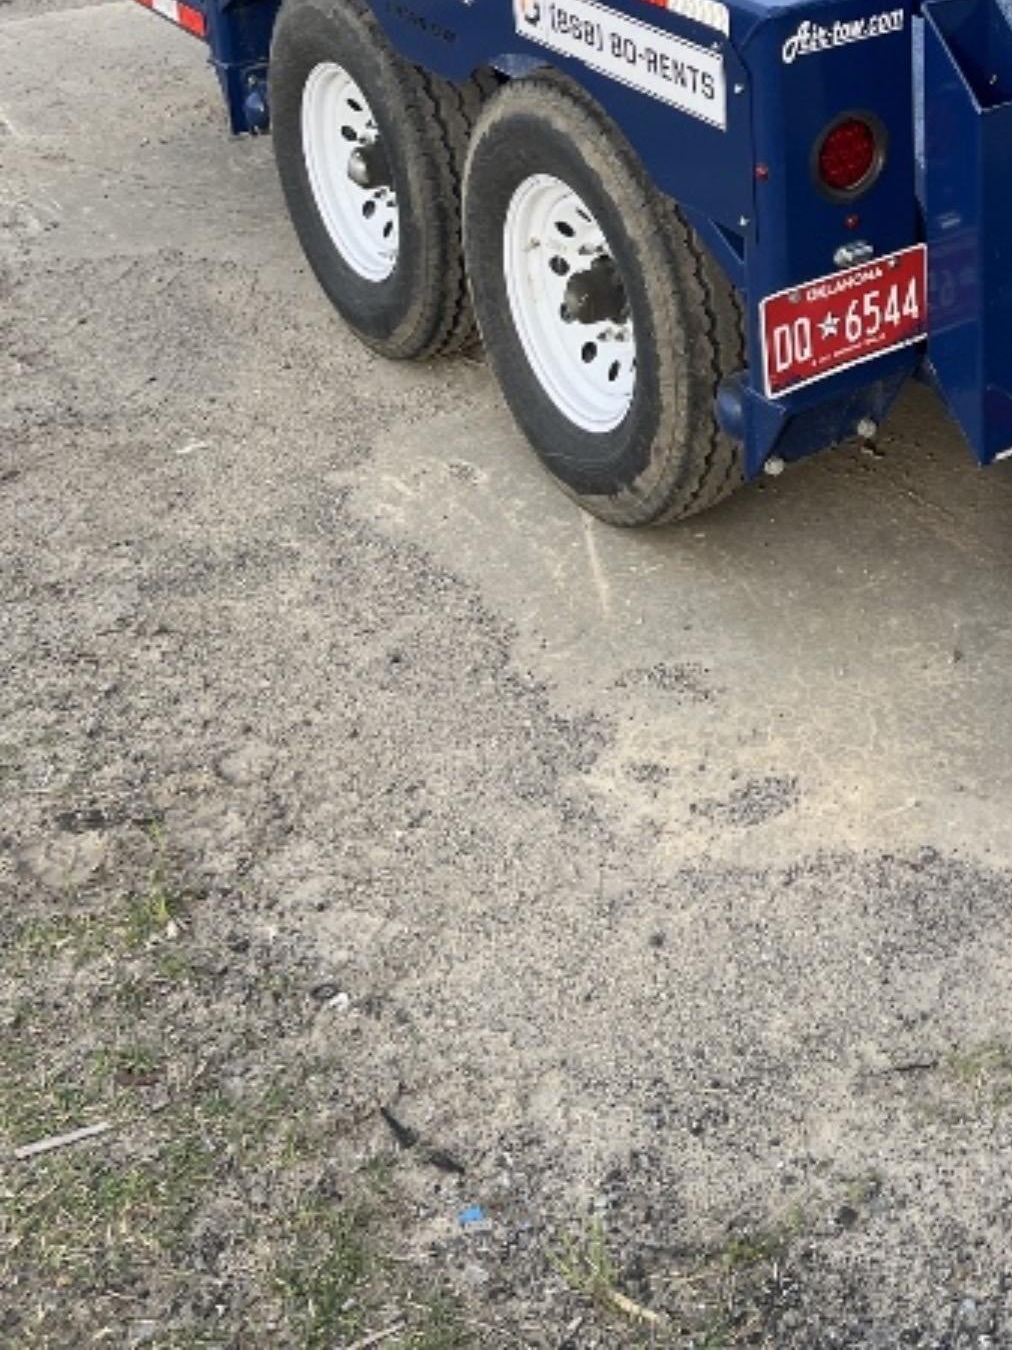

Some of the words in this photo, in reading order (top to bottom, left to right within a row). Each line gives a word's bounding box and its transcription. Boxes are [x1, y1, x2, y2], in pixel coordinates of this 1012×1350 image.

[805, 267, 884, 302] OKLAHOMA
[773, 316, 813, 373] DQ
[845, 276, 919, 342] 6544
